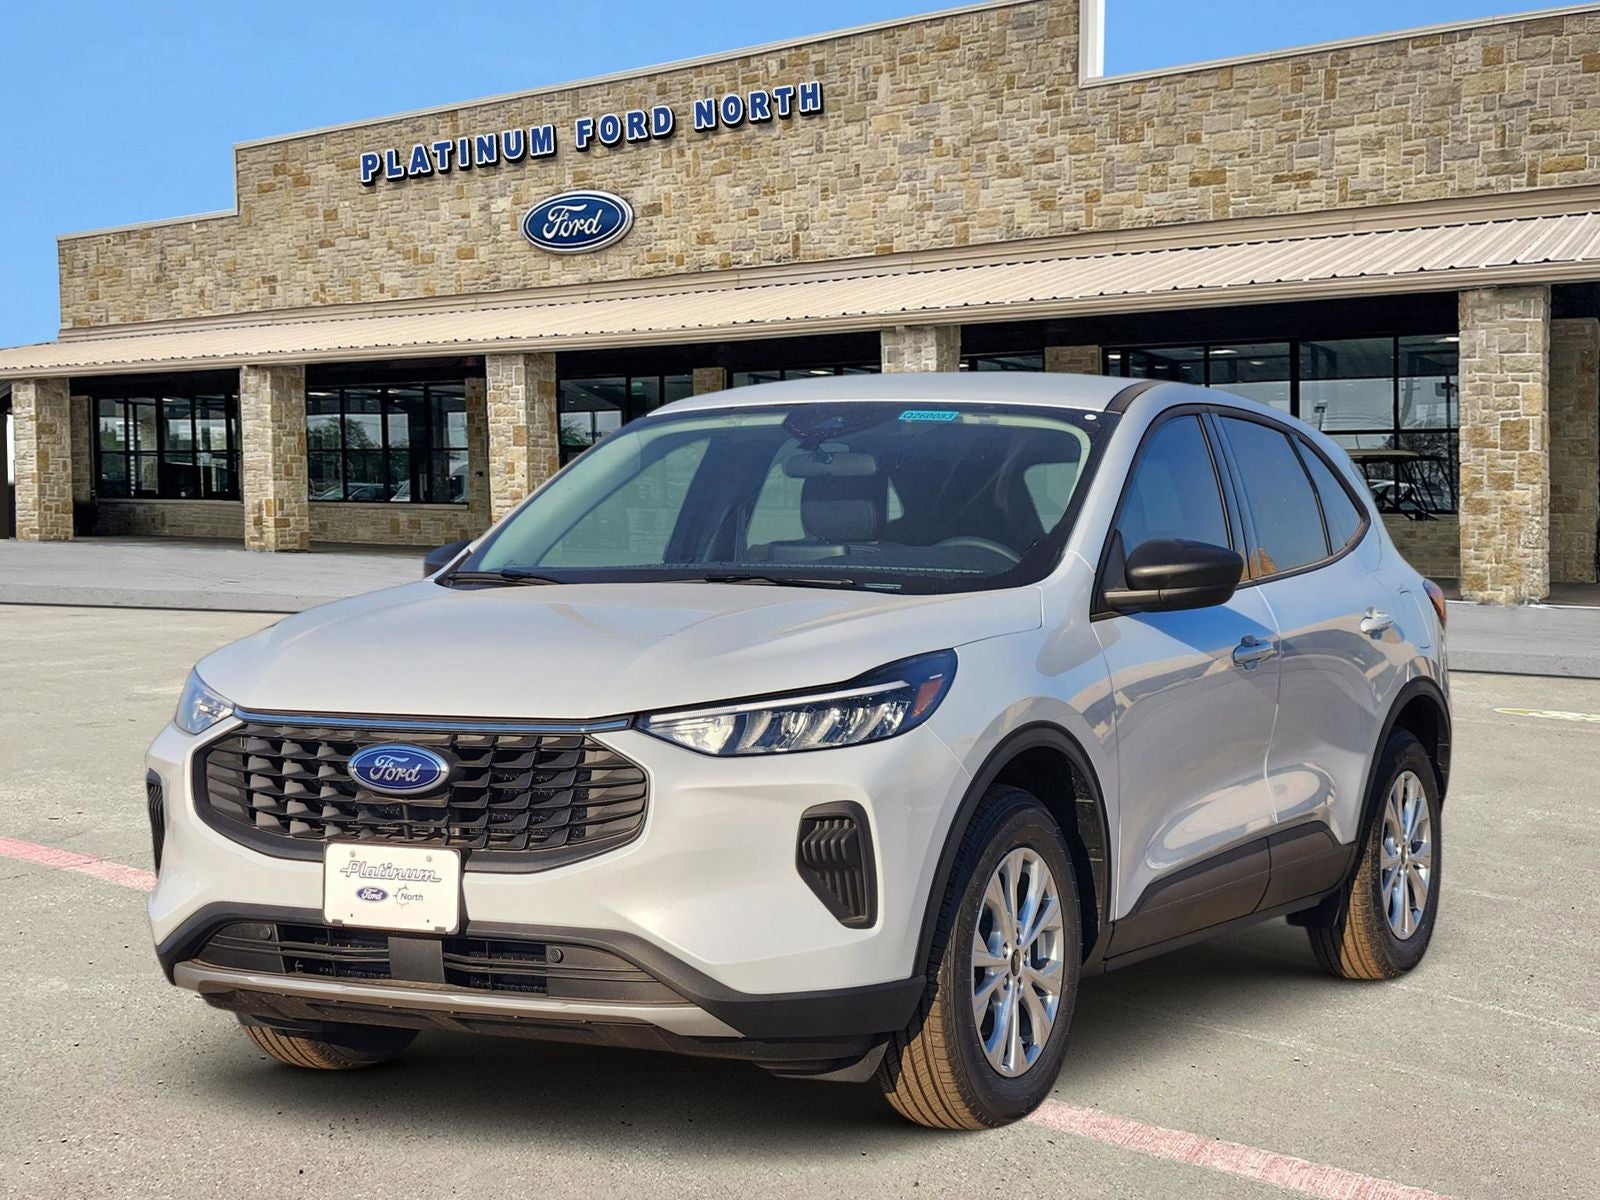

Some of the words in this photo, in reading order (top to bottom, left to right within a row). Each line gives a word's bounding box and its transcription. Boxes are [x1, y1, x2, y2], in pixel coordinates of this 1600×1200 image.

[361, 125, 556, 185] PLATINUM
[576, 106, 674, 151] FORD
[694, 82, 823, 131] NORTH
[542, 204, 602, 239] Ford
[369, 755, 420, 782] Ford
[340, 860, 442, 883] Platinum
[360, 889, 383, 901] Ford
[400, 892, 423, 902] North
